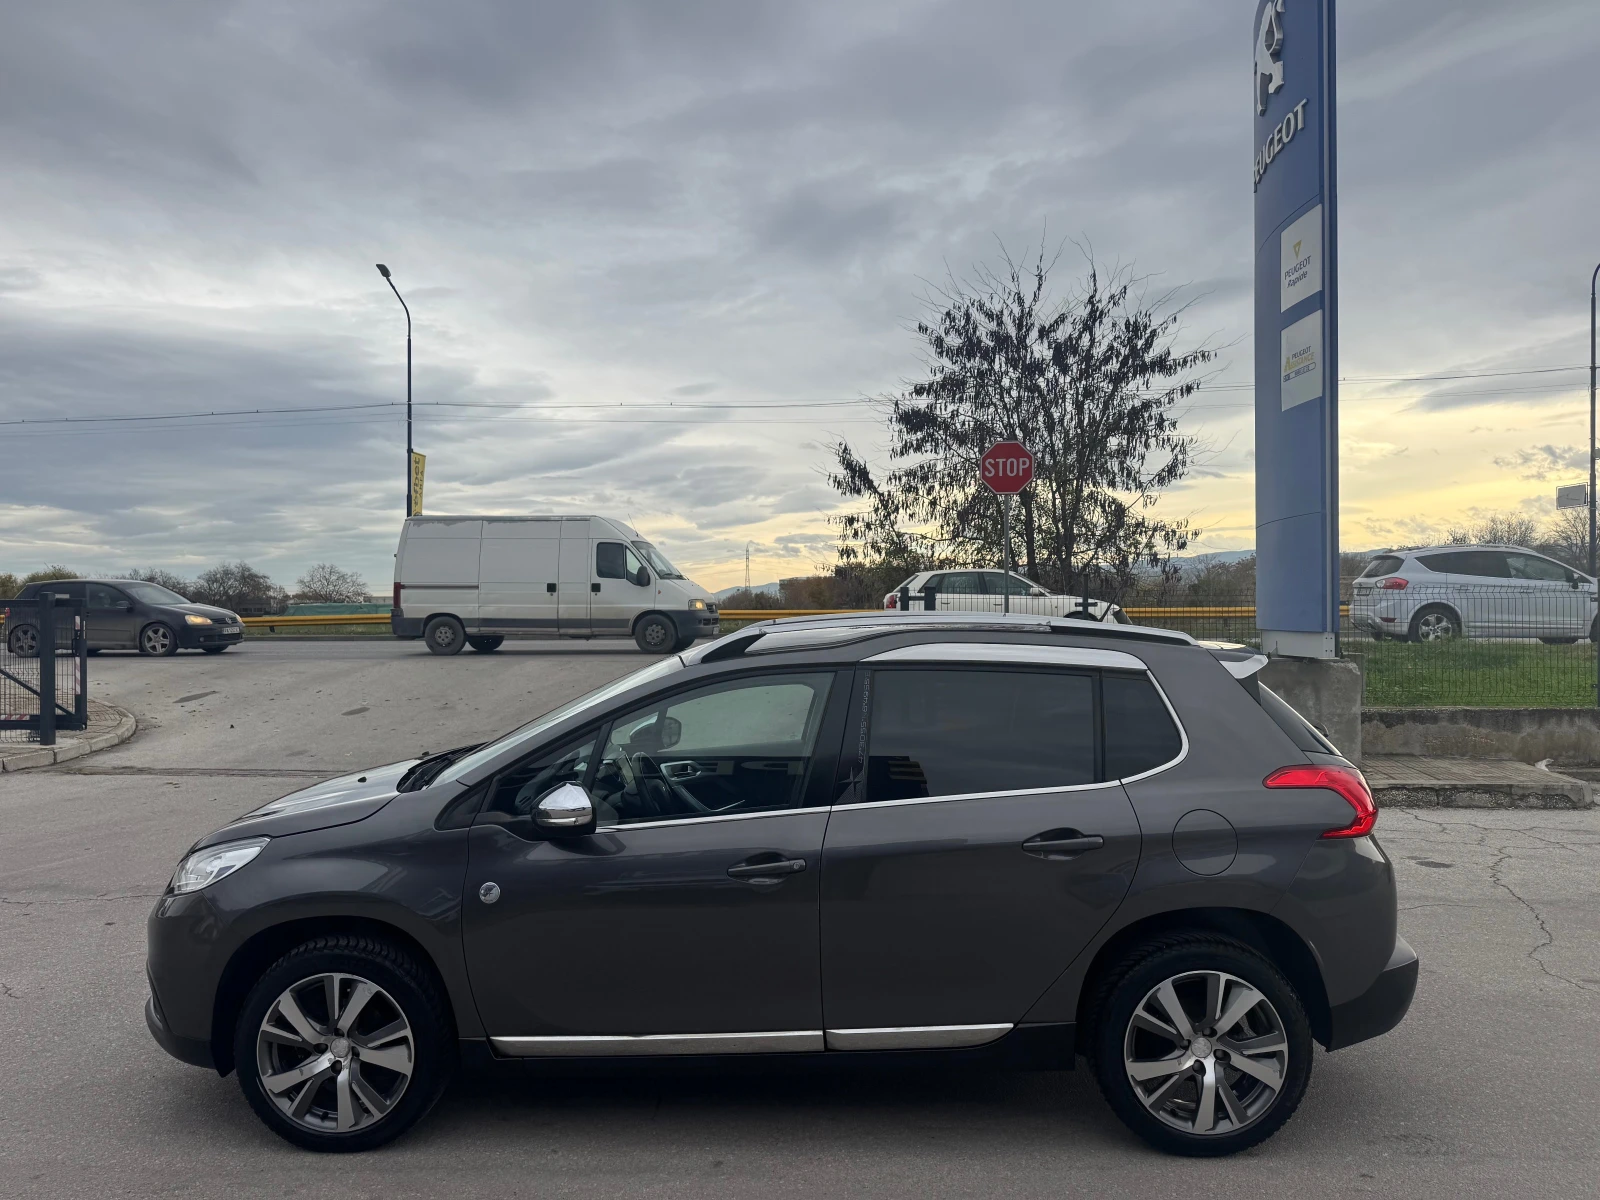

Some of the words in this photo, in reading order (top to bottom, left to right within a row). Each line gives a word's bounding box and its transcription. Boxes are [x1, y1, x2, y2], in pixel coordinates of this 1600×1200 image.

[1254, 98, 1307, 192] EUGEOT
[1284, 255, 1311, 280] PEUGEOT
[1291, 345, 1311, 360] PEUGEOT
[984, 457, 1030, 477] STOP
